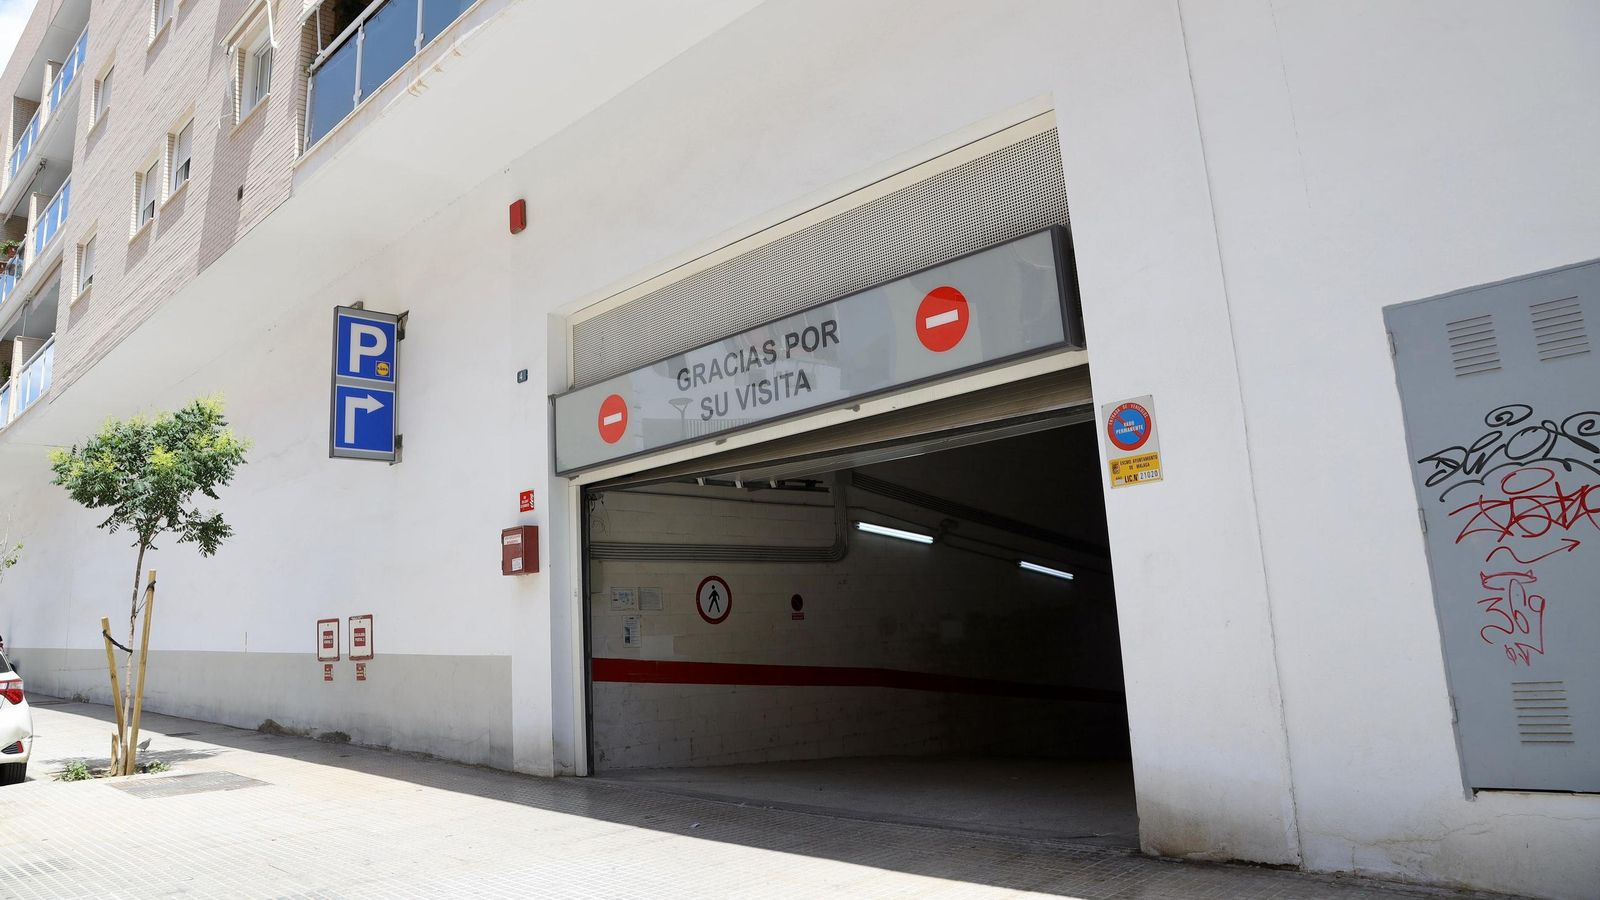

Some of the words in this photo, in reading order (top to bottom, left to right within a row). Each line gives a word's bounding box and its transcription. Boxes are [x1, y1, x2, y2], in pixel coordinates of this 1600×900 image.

[349, 322, 388, 373] P
[676, 339, 777, 391] GRACIAS
[785, 319, 840, 359] POR
[700, 391, 729, 421] SU
[736, 369, 812, 411] VISITA
